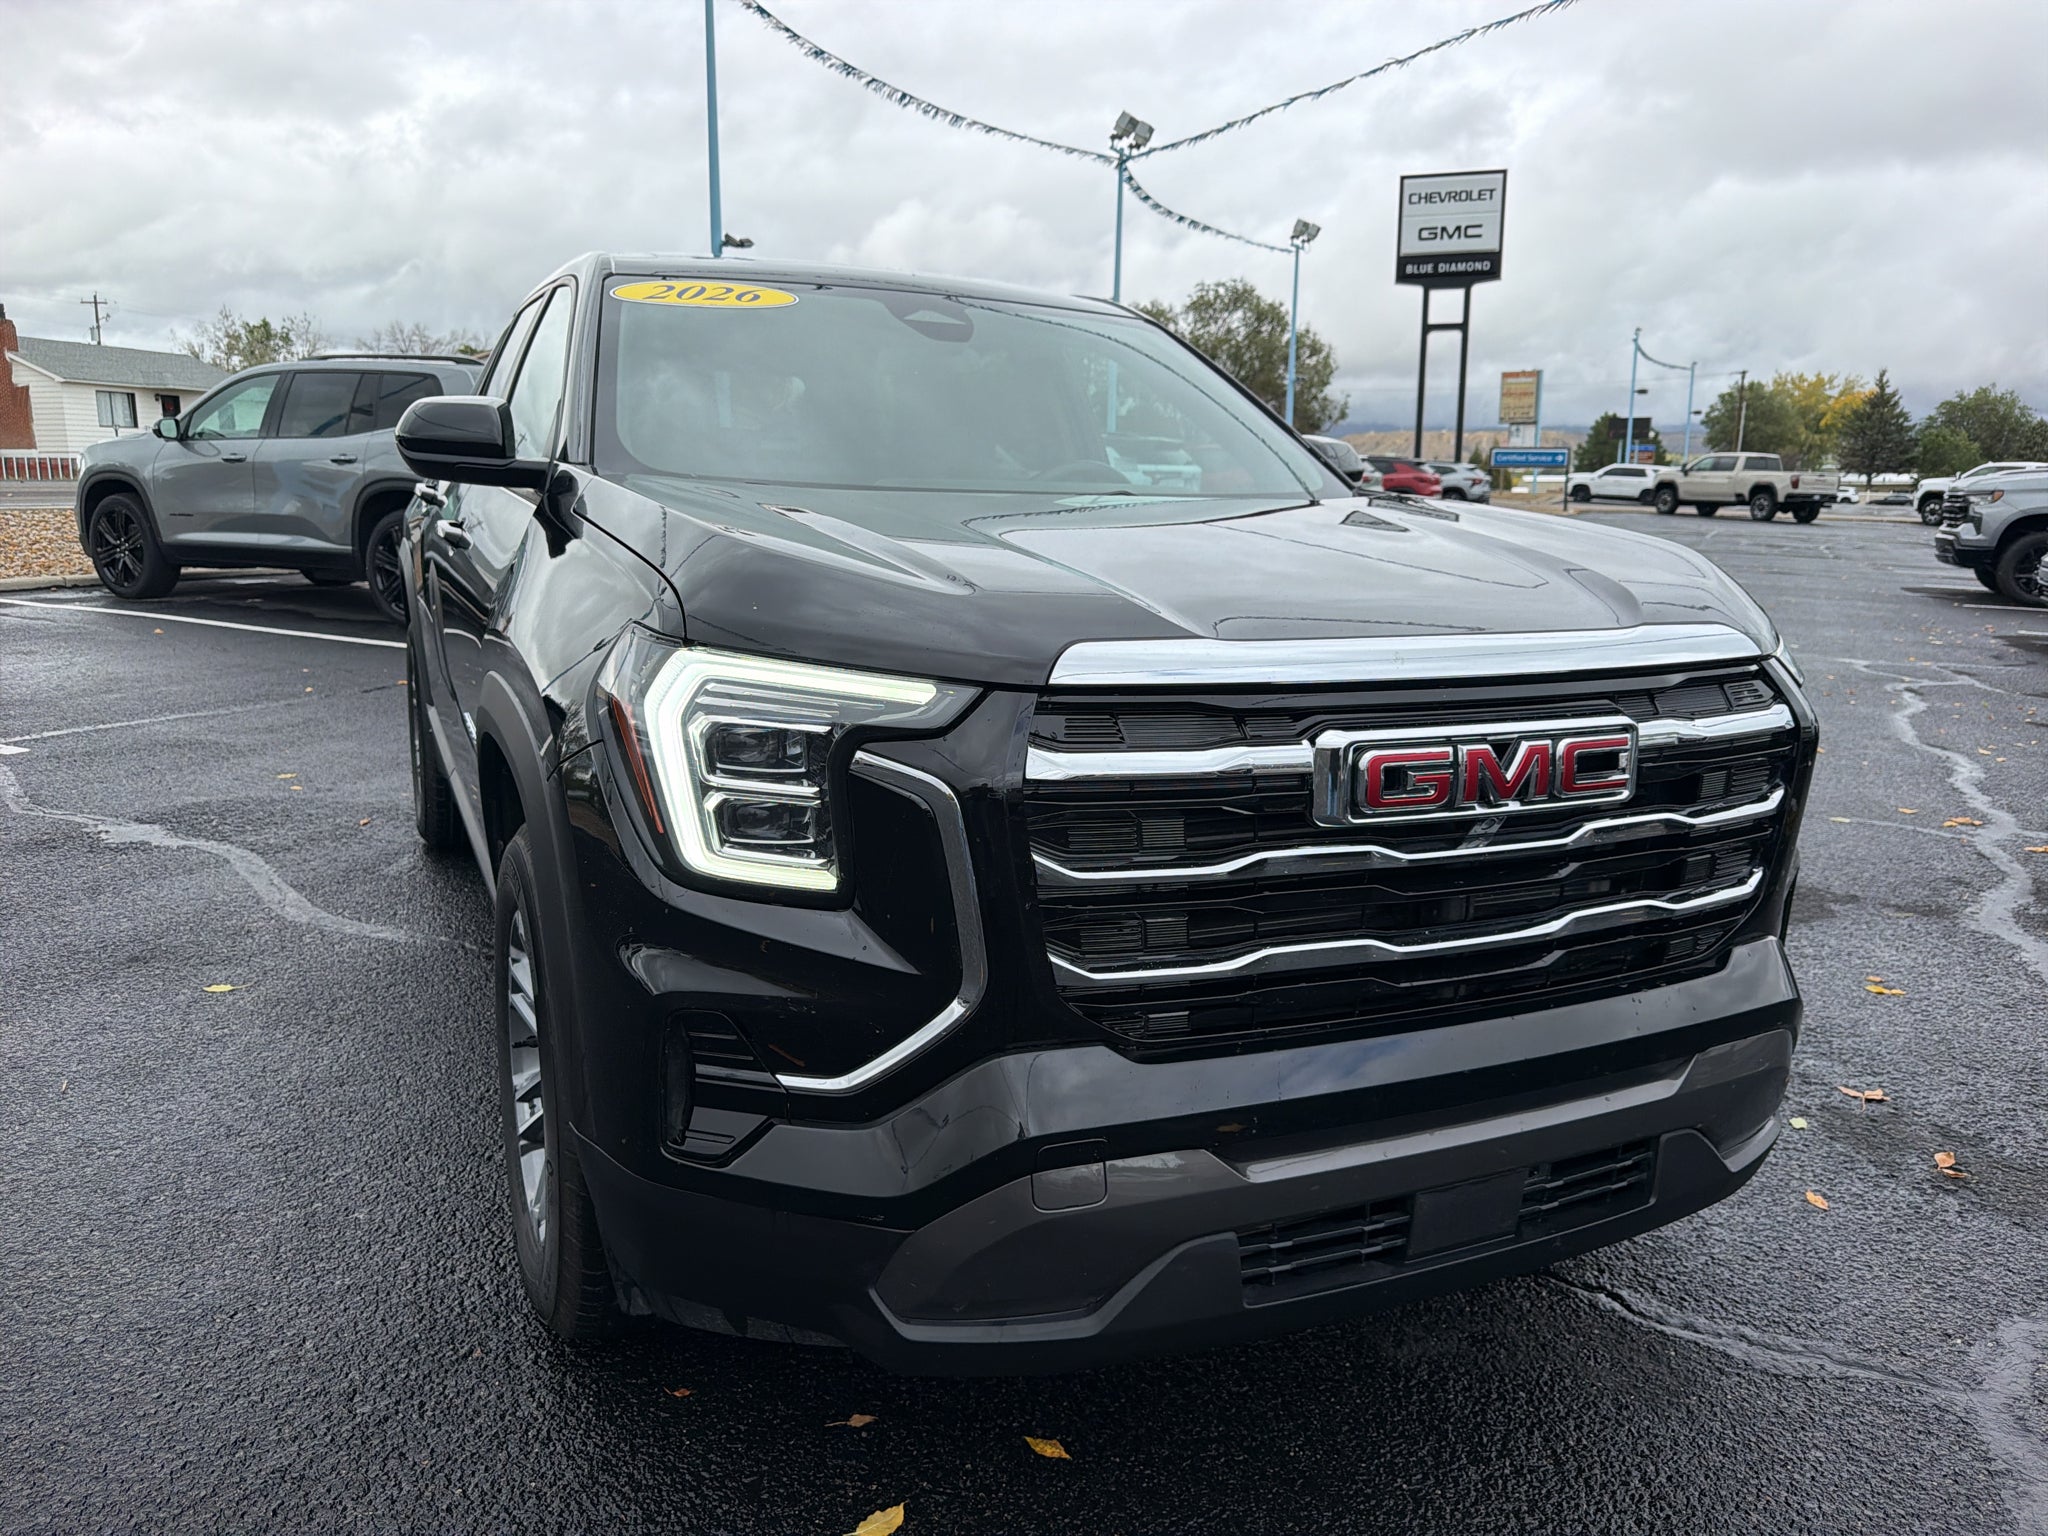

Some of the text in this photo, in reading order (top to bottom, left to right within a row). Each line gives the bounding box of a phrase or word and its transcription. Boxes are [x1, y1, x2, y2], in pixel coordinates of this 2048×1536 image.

[1408, 188, 1496, 205] CHEVROLET
[1418, 224, 1483, 241] GMC
[1405, 260, 1491, 275] BLUE DIAMOND
[643, 284, 768, 303] 2026
[1358, 734, 1632, 813] GMC
